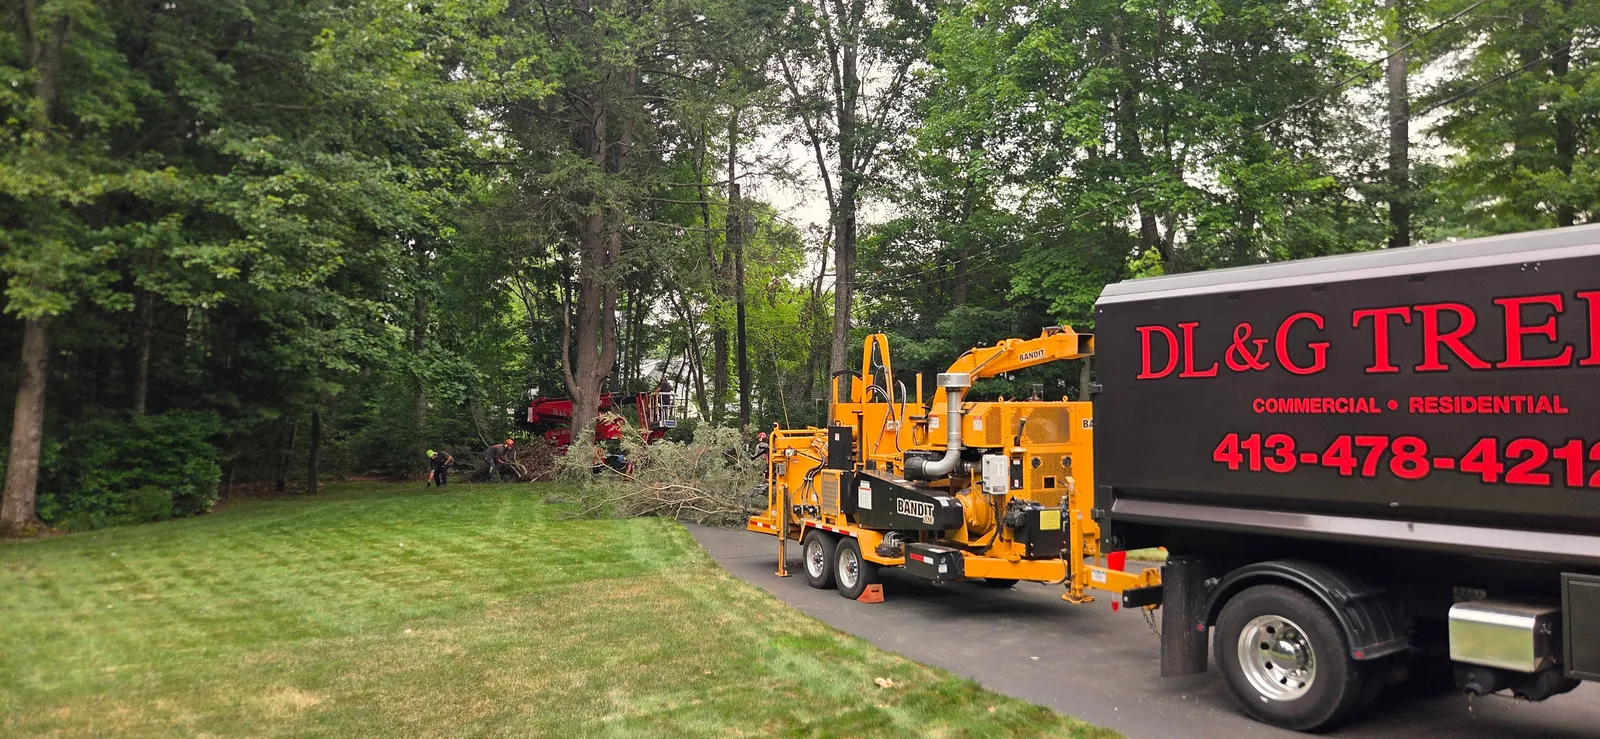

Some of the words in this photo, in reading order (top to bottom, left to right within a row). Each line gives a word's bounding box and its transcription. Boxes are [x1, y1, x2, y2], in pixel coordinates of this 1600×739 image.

[1018, 349, 1045, 362] BANDIT
[1136, 312, 1331, 380] DL&G
[1252, 397, 1382, 414] COMMERCIAL
[1409, 395, 1569, 414] RESIDENTIAL
[1213, 433, 1600, 488] 413-478-421
[897, 498, 935, 518] BANDIT
